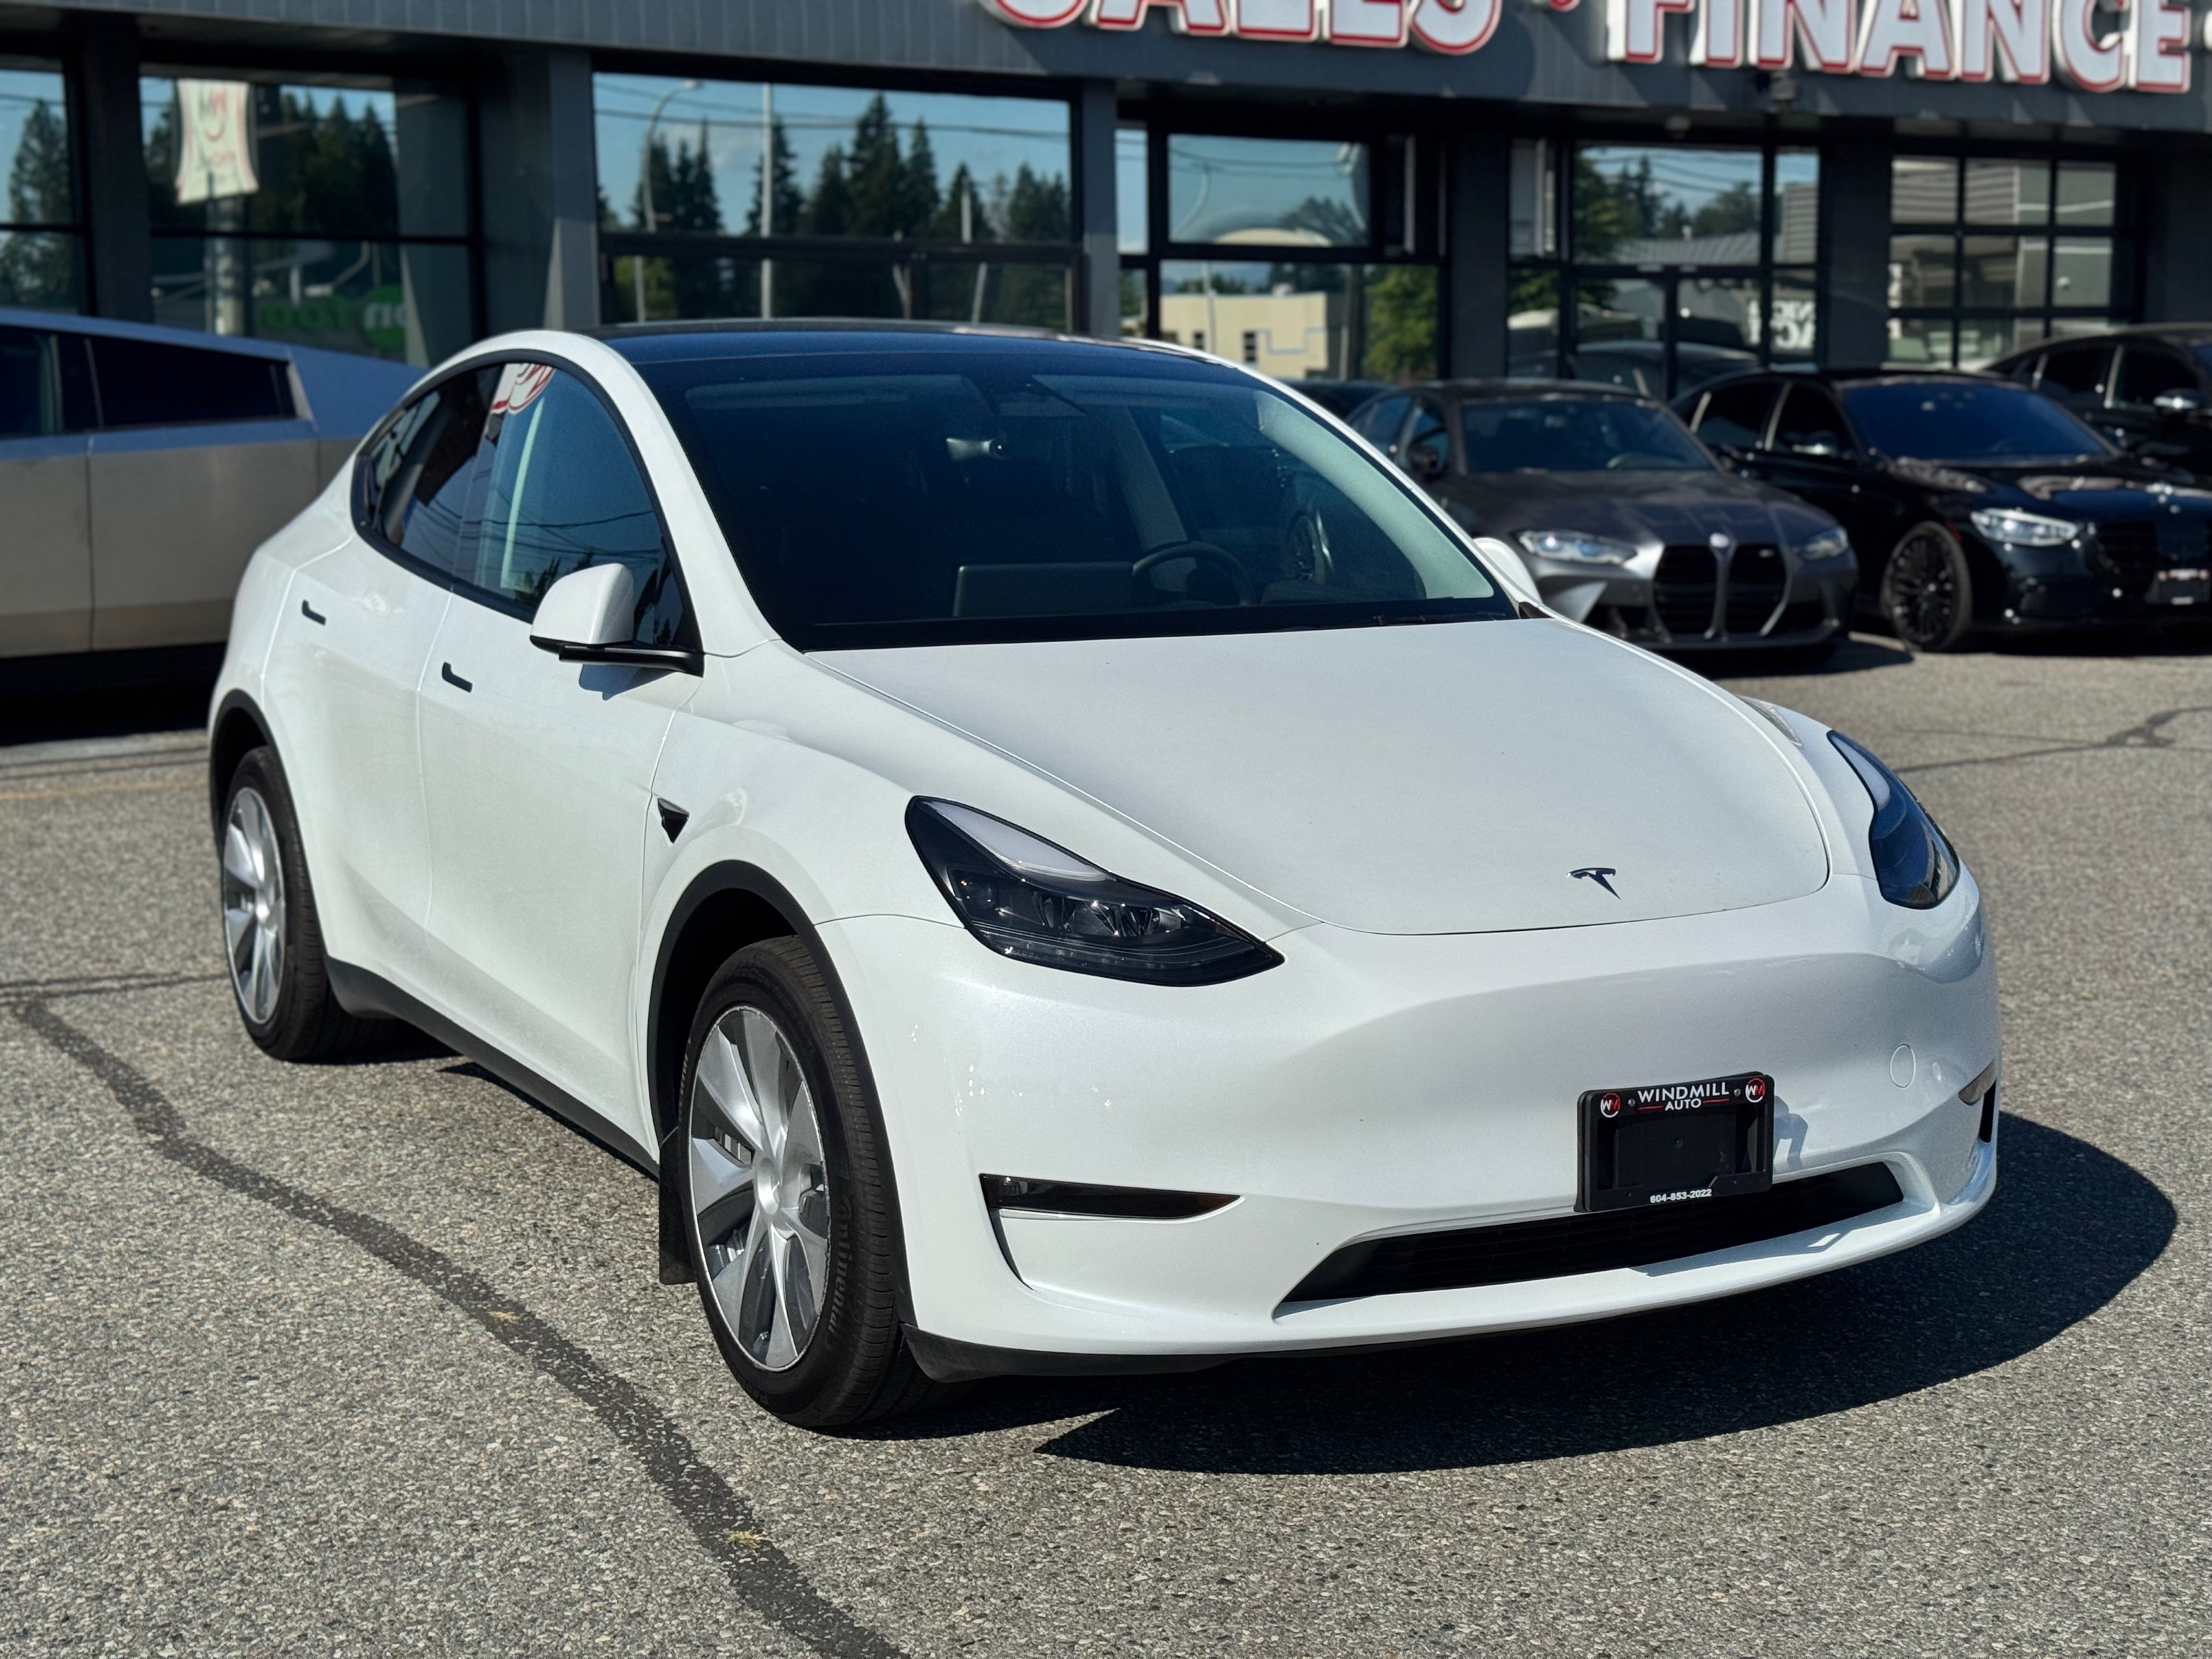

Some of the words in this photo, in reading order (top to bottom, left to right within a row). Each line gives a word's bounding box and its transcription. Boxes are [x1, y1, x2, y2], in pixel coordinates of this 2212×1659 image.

[1637, 1082, 1730, 1103] WINDMILL
[1665, 1098, 1701, 1111] AUTO
[1650, 1188, 1712, 1204] 604-853-2022
